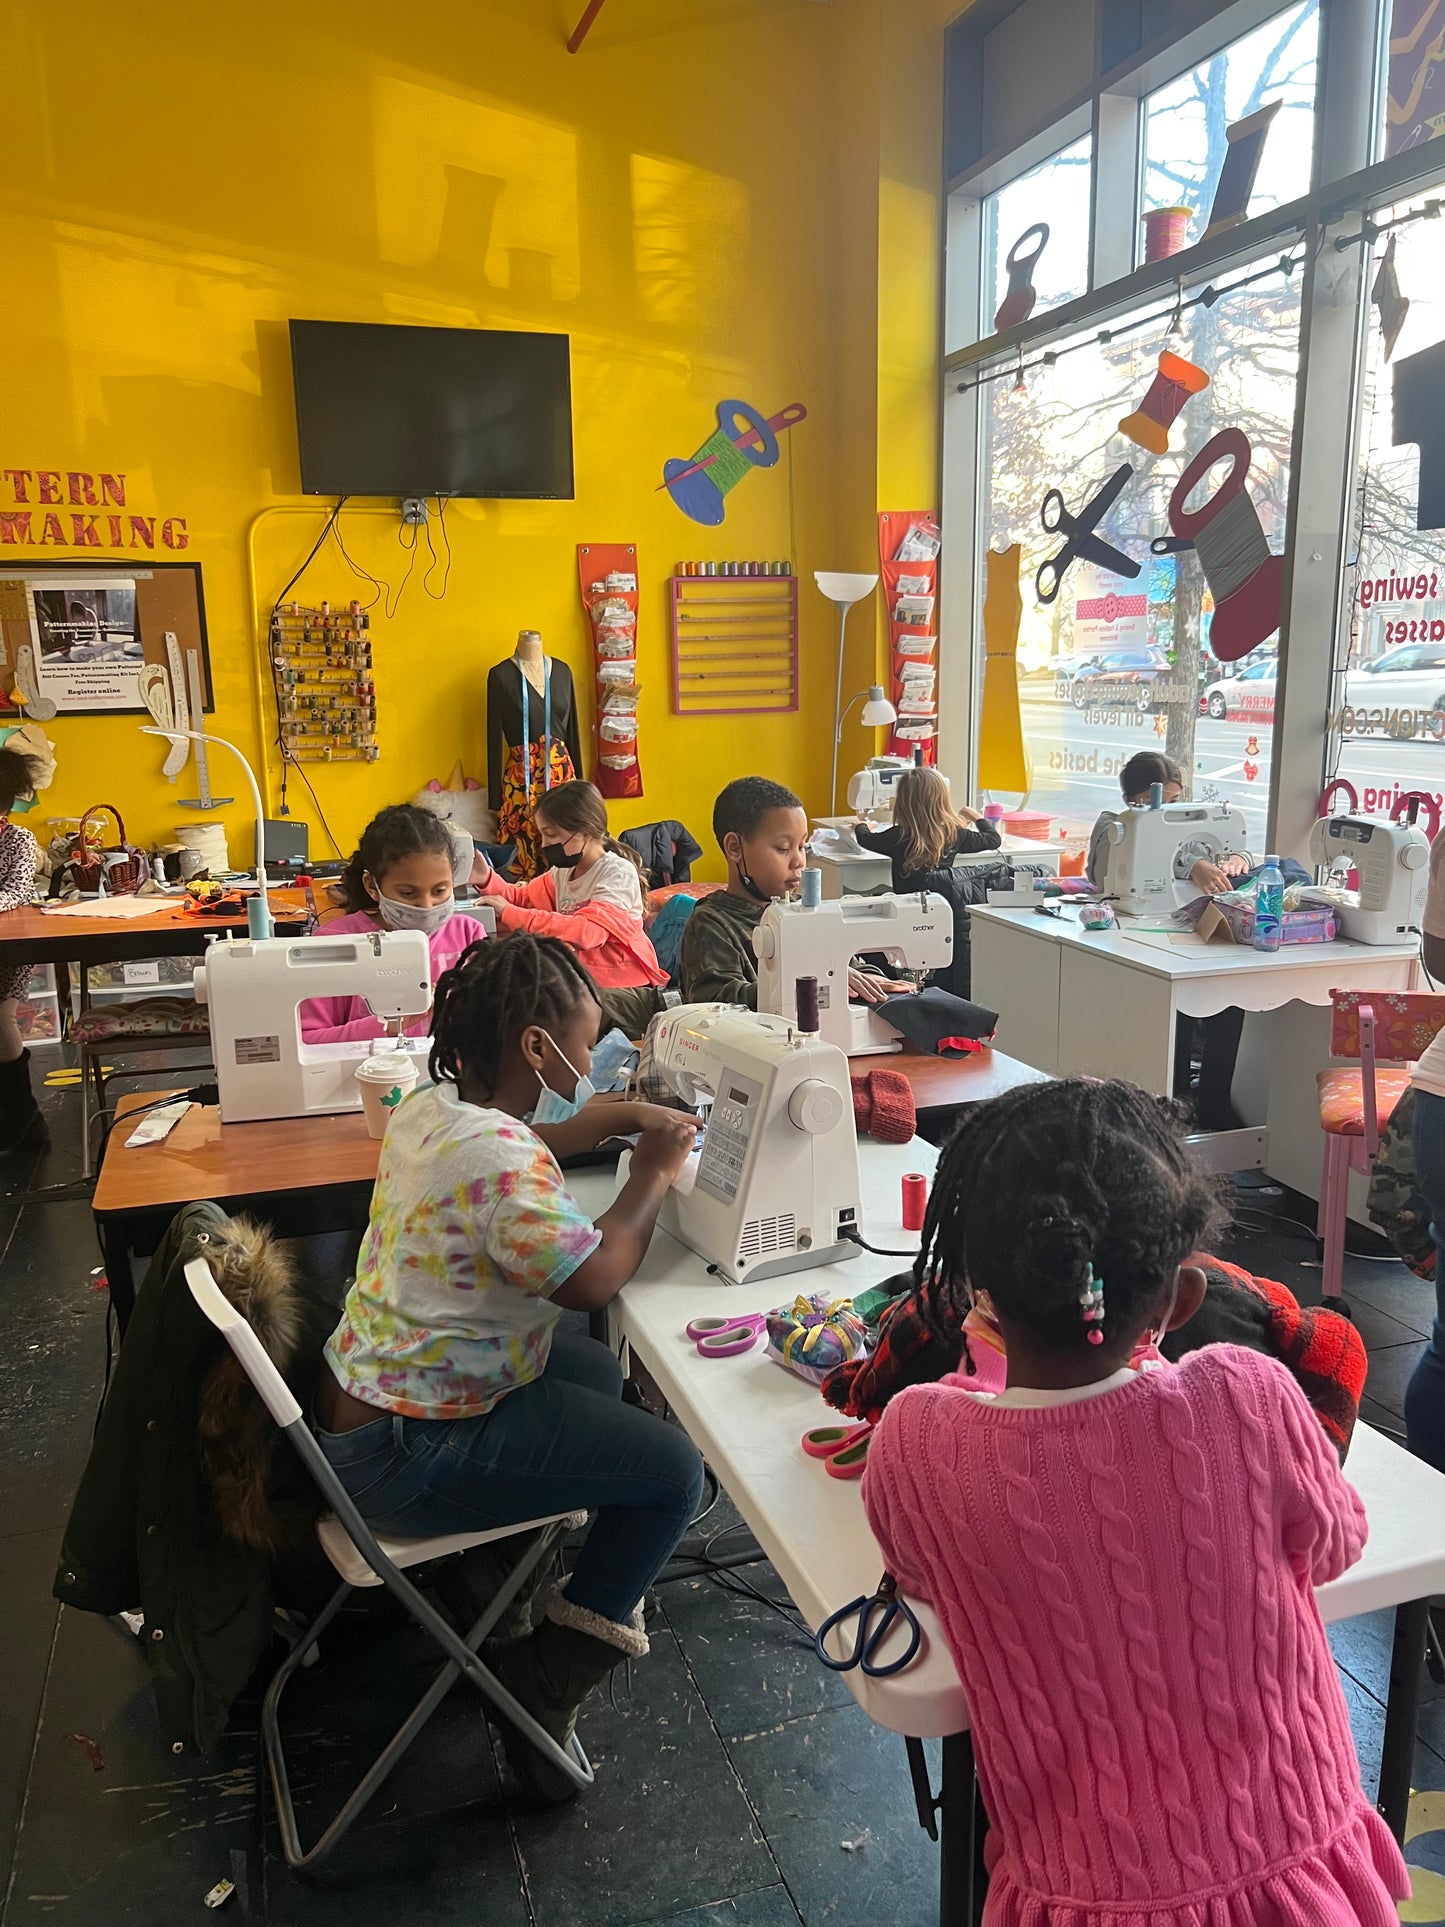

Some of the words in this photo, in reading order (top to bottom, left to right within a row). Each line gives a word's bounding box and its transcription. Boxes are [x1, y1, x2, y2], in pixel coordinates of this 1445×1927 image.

[0, 469, 127, 507] TERN
[0, 511, 190, 550] MAKING
[912, 924, 935, 932] brother
[376, 967, 412, 977] brother
[678, 1037, 700, 1053] SINGER
